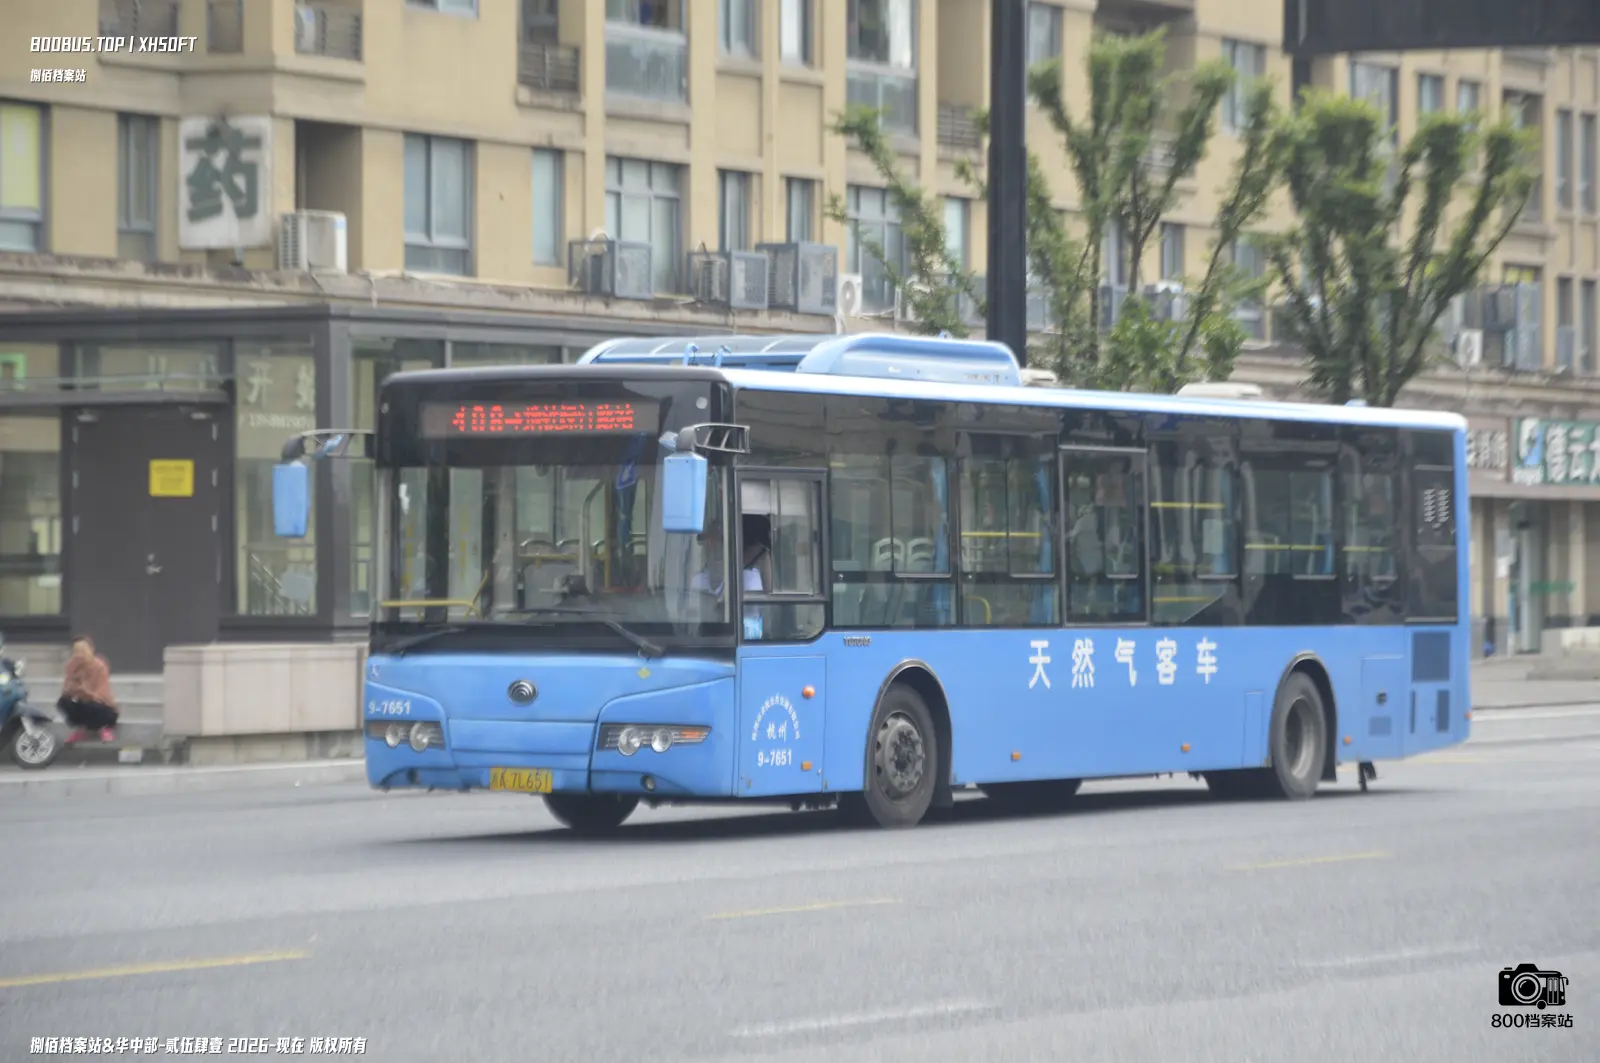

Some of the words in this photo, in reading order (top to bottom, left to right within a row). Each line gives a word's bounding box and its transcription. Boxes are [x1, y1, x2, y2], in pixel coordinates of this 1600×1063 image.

[185, 116, 262, 221] 药
[1028, 637, 1218, 689] 天然气客车
[368, 700, 411, 715] 9-7651
[757, 749, 792, 767] 9-7651
